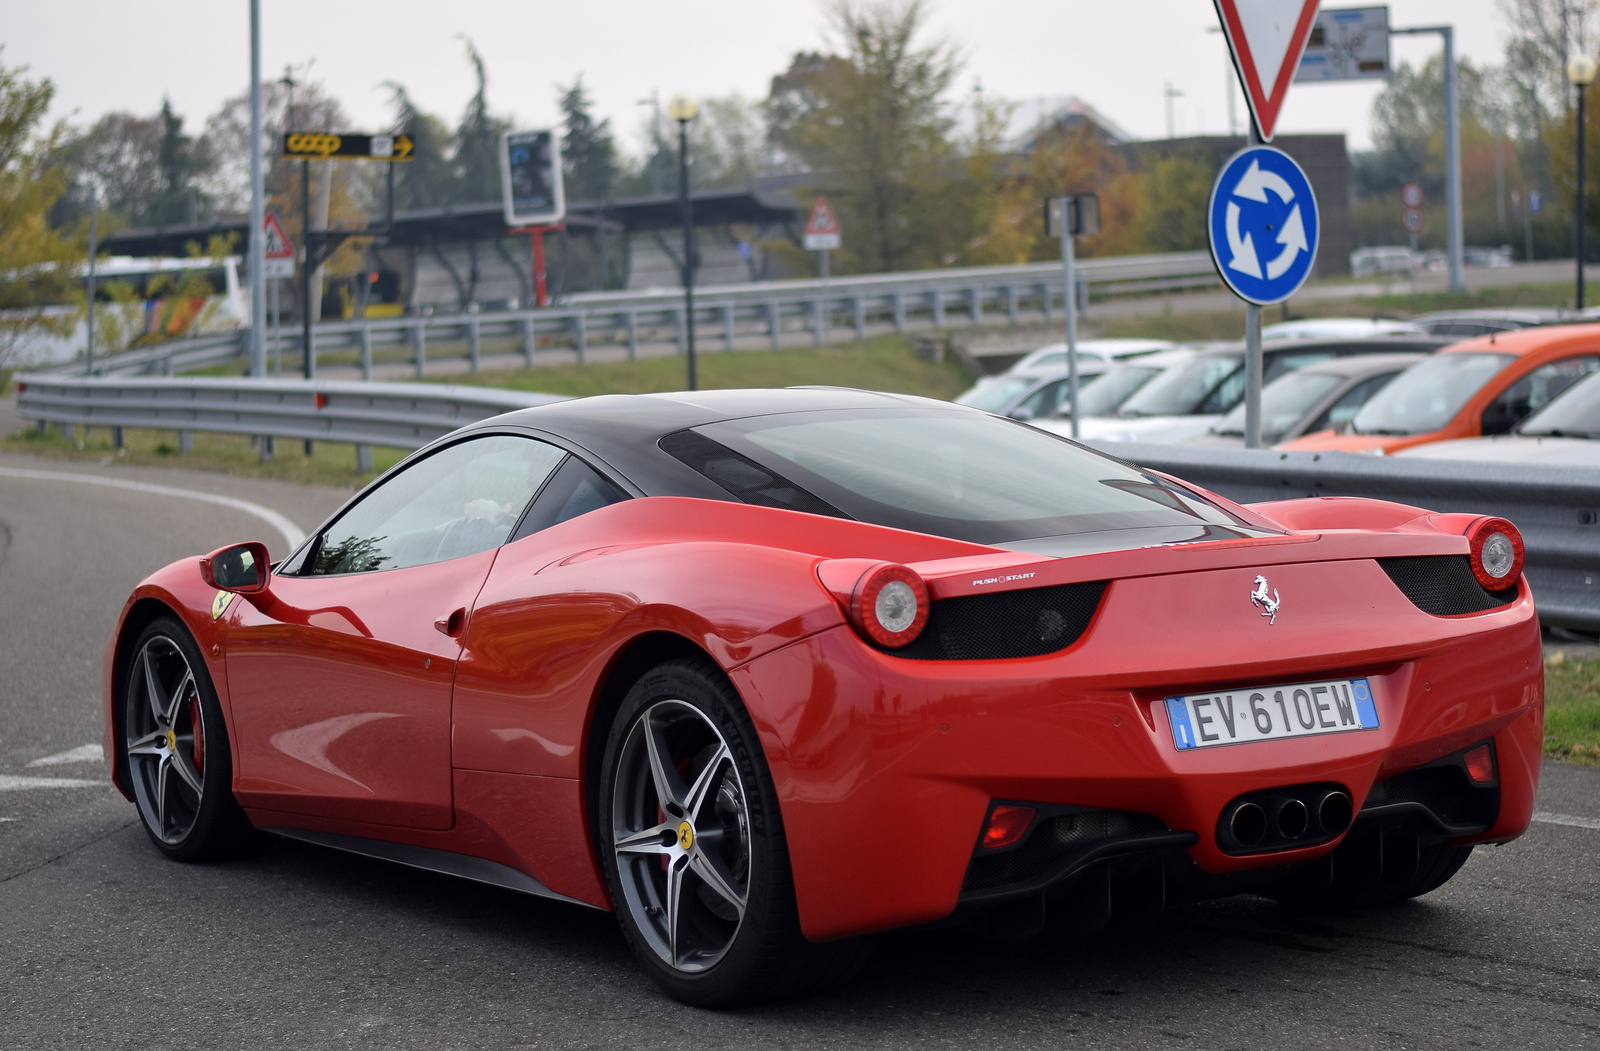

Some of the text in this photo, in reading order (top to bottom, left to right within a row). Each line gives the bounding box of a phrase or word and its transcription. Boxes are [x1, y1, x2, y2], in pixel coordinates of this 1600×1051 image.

[287, 133, 341, 158] coop
[972, 572, 1036, 586] PUSH START
[1191, 684, 1356, 742] EV 610EW
[724, 720, 766, 830] MICHELIN
